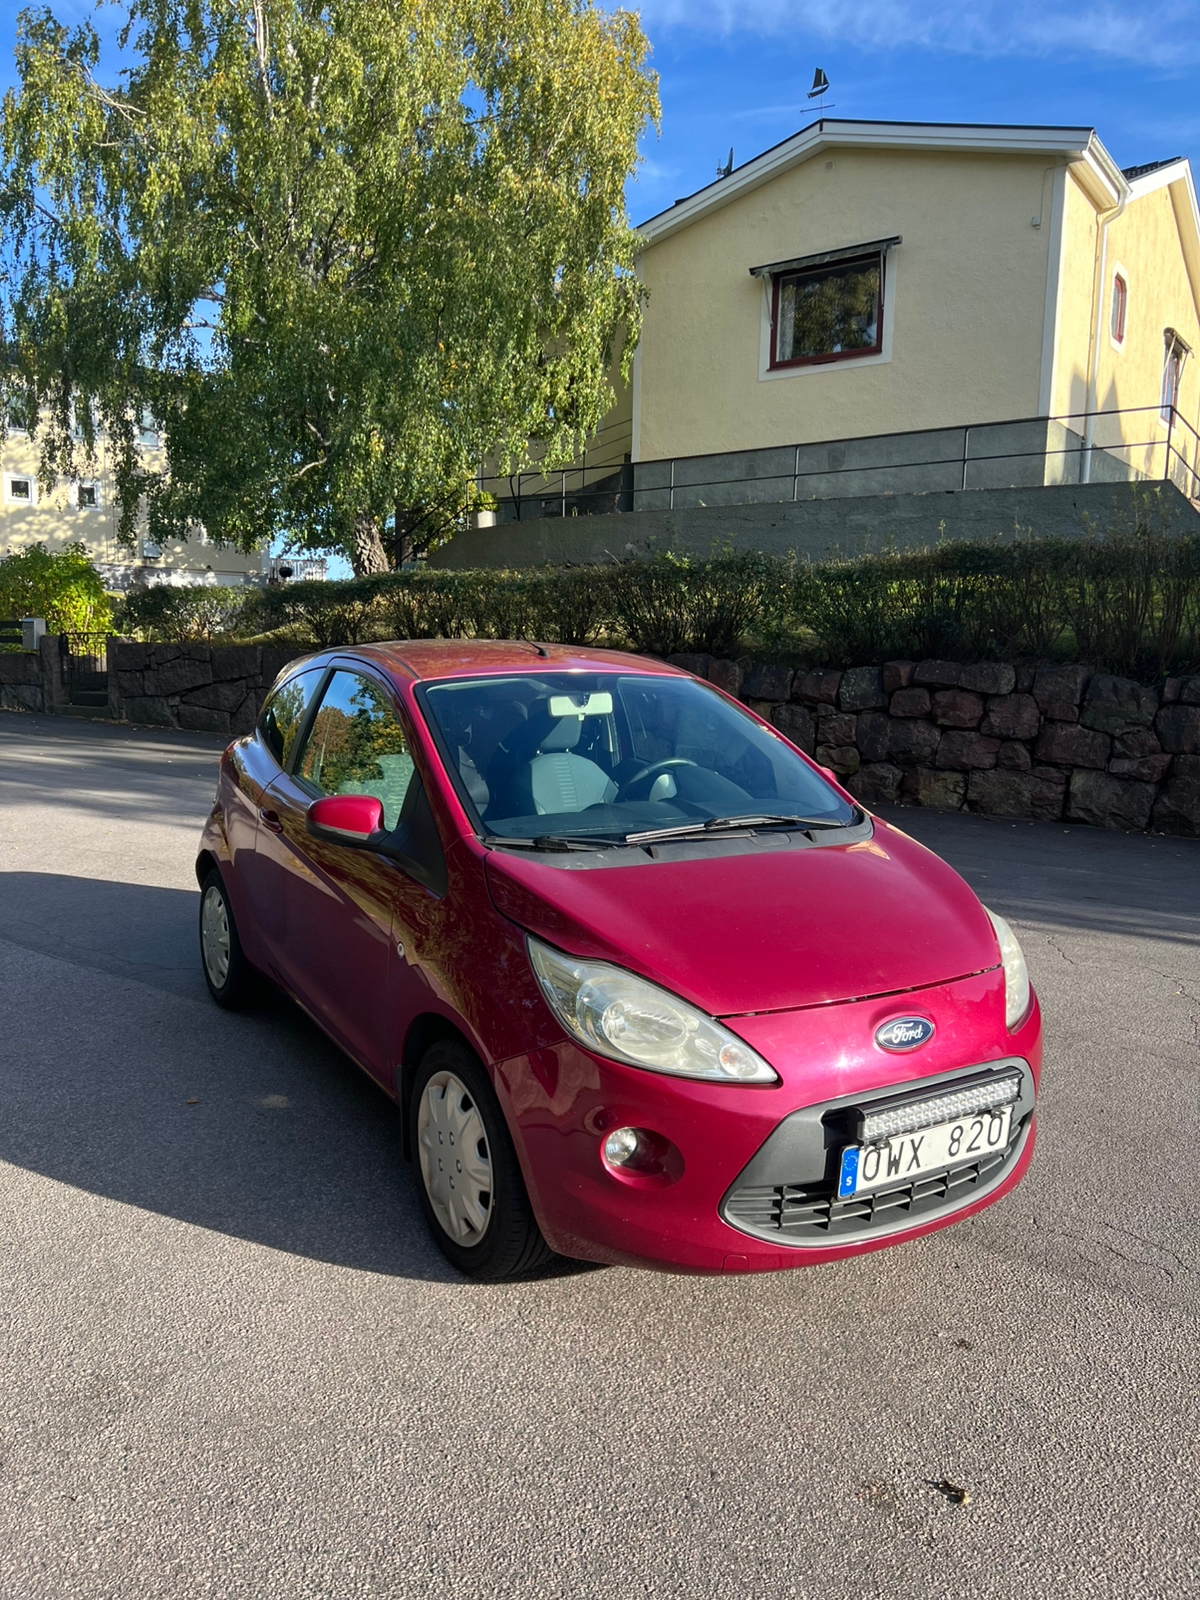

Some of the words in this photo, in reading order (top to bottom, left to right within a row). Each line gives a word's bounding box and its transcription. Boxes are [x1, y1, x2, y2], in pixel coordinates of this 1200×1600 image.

[892, 1022, 923, 1044] Ford
[862, 1135, 925, 1182] OWX
[948, 1116, 1003, 1157] 820
[845, 1176, 853, 1187] S
